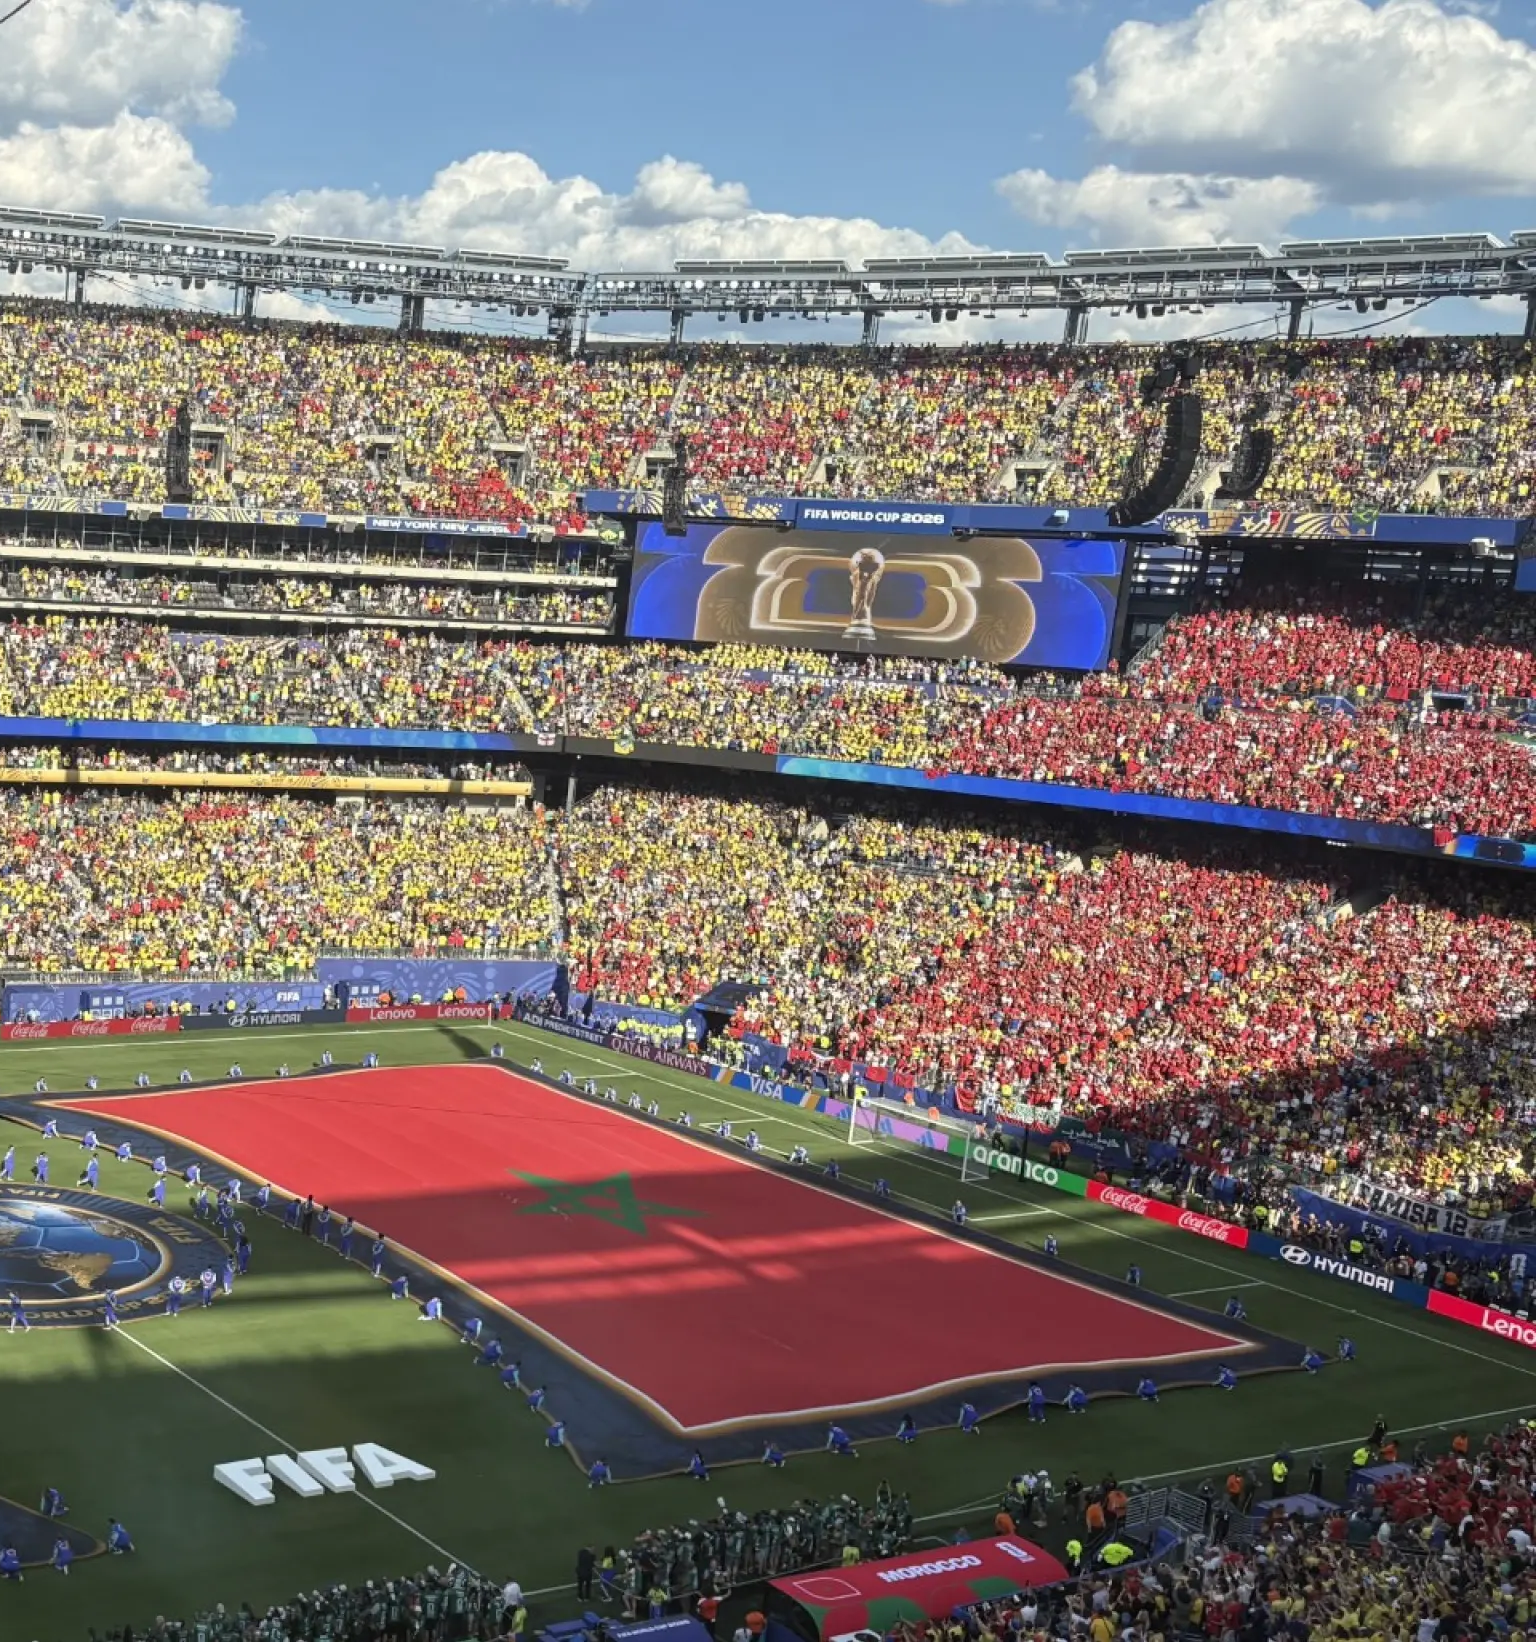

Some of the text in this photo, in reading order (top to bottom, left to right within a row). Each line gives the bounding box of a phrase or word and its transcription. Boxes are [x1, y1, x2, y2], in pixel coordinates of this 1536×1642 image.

[372, 519, 401, 530] NEW
[404, 520, 438, 531] YORK
[440, 522, 469, 532] NEW
[804, 508, 945, 524] FIFA WORLD CUP 2026
[276, 991, 300, 1003] FIFA
[250, 1013, 301, 1026] HYUNDAI
[370, 1007, 416, 1020] Lenovo
[437, 1003, 486, 1018] Lenovo
[610, 1036, 707, 1075] QATAR AIRWAYS
[750, 1076, 784, 1100] VISA
[1100, 1186, 1148, 1215] Coca-Cola
[1178, 1211, 1230, 1241] Coca-Cola
[1313, 1255, 1395, 1294] HYUNDAI
[214, 1442, 436, 1506] FIFA
[876, 1554, 983, 1583] MOROCCO
